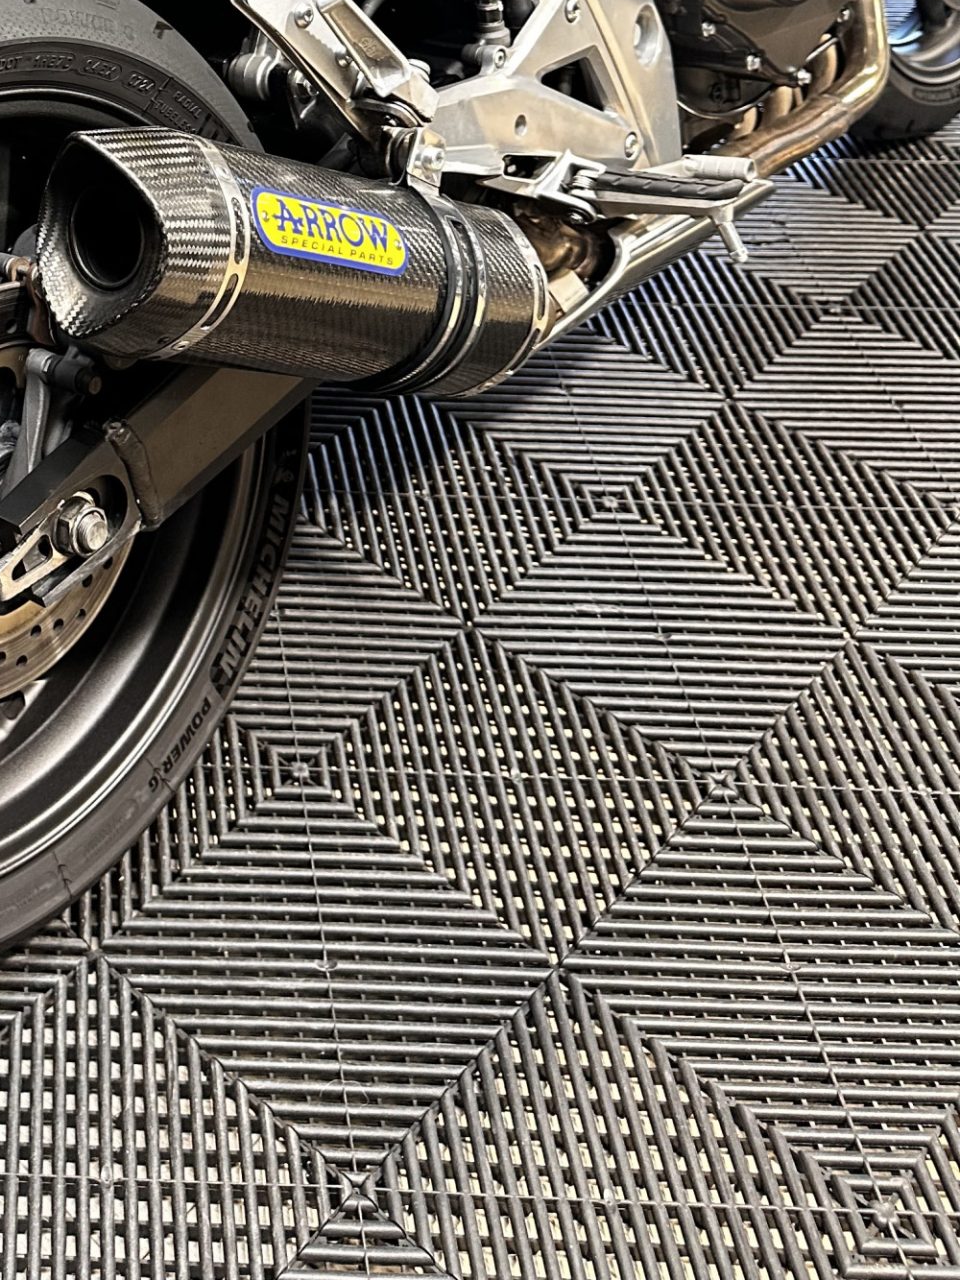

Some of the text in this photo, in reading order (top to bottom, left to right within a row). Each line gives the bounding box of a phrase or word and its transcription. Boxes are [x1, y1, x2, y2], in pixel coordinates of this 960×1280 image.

[272, 198, 389, 254] ARROW
[280, 234, 394, 266] SPECIAL PARTS
[219, 492, 291, 677] MICHELIN
[161, 696, 212, 775] POWER
